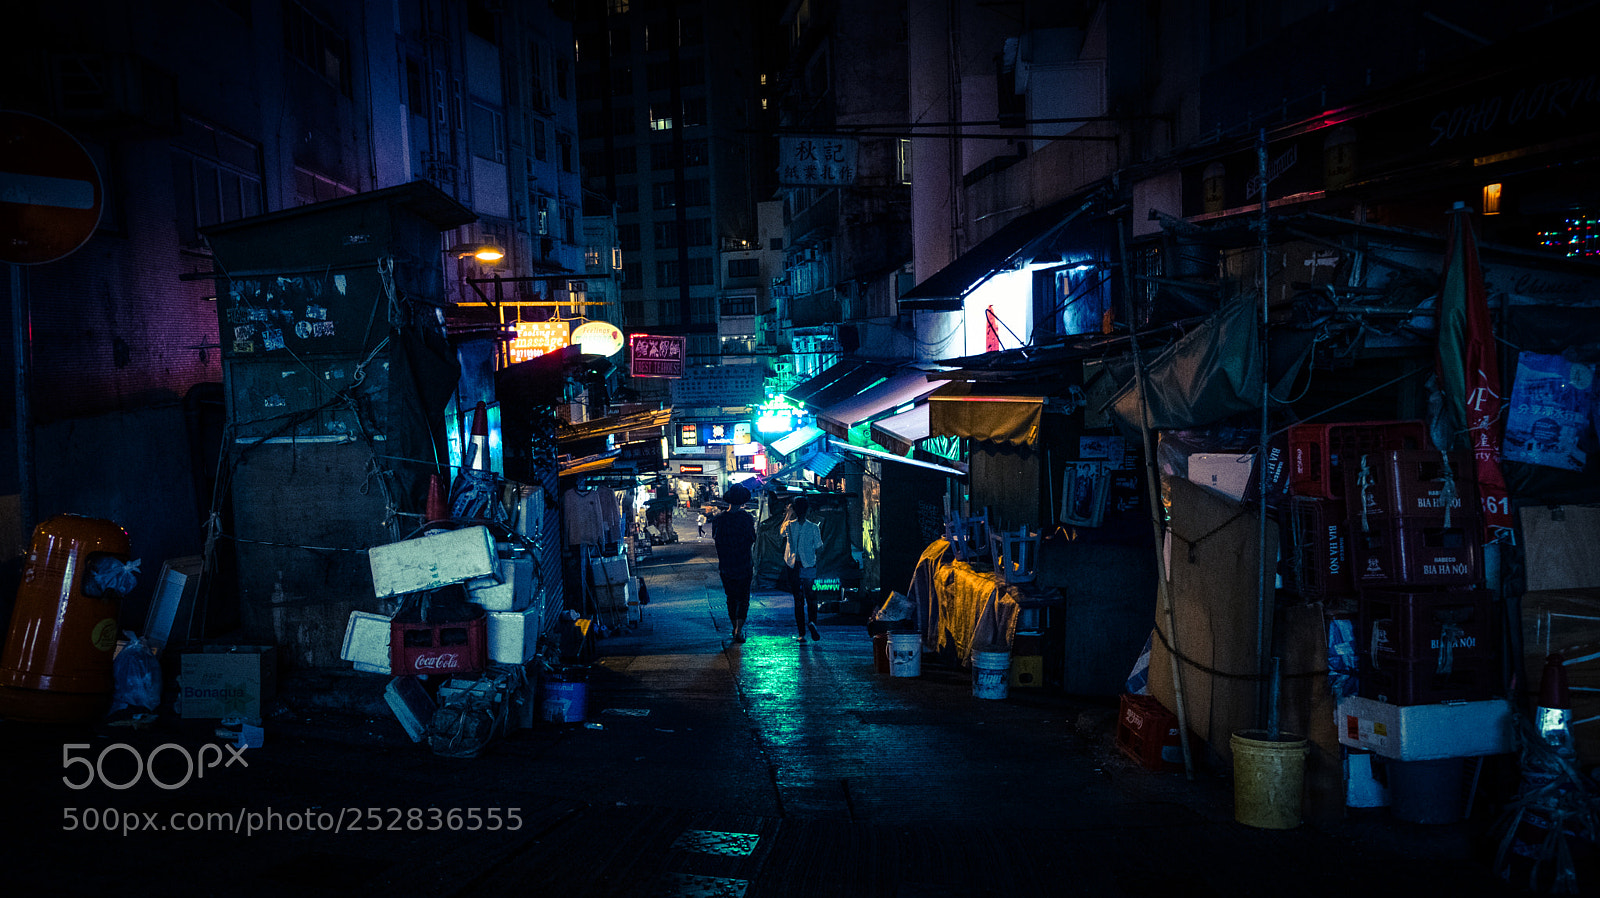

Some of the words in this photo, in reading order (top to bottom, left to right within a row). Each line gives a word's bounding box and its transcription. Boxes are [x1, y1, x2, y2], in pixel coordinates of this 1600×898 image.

[795, 140, 845, 163] 秋記
[517, 328, 556, 341] Feelings
[515, 336, 564, 352] massage
[1268, 447, 1281, 461] BIA
[1417, 497, 1432, 508] BIA
[1328, 525, 1338, 541] BIA
[1423, 565, 1437, 575] BIA
